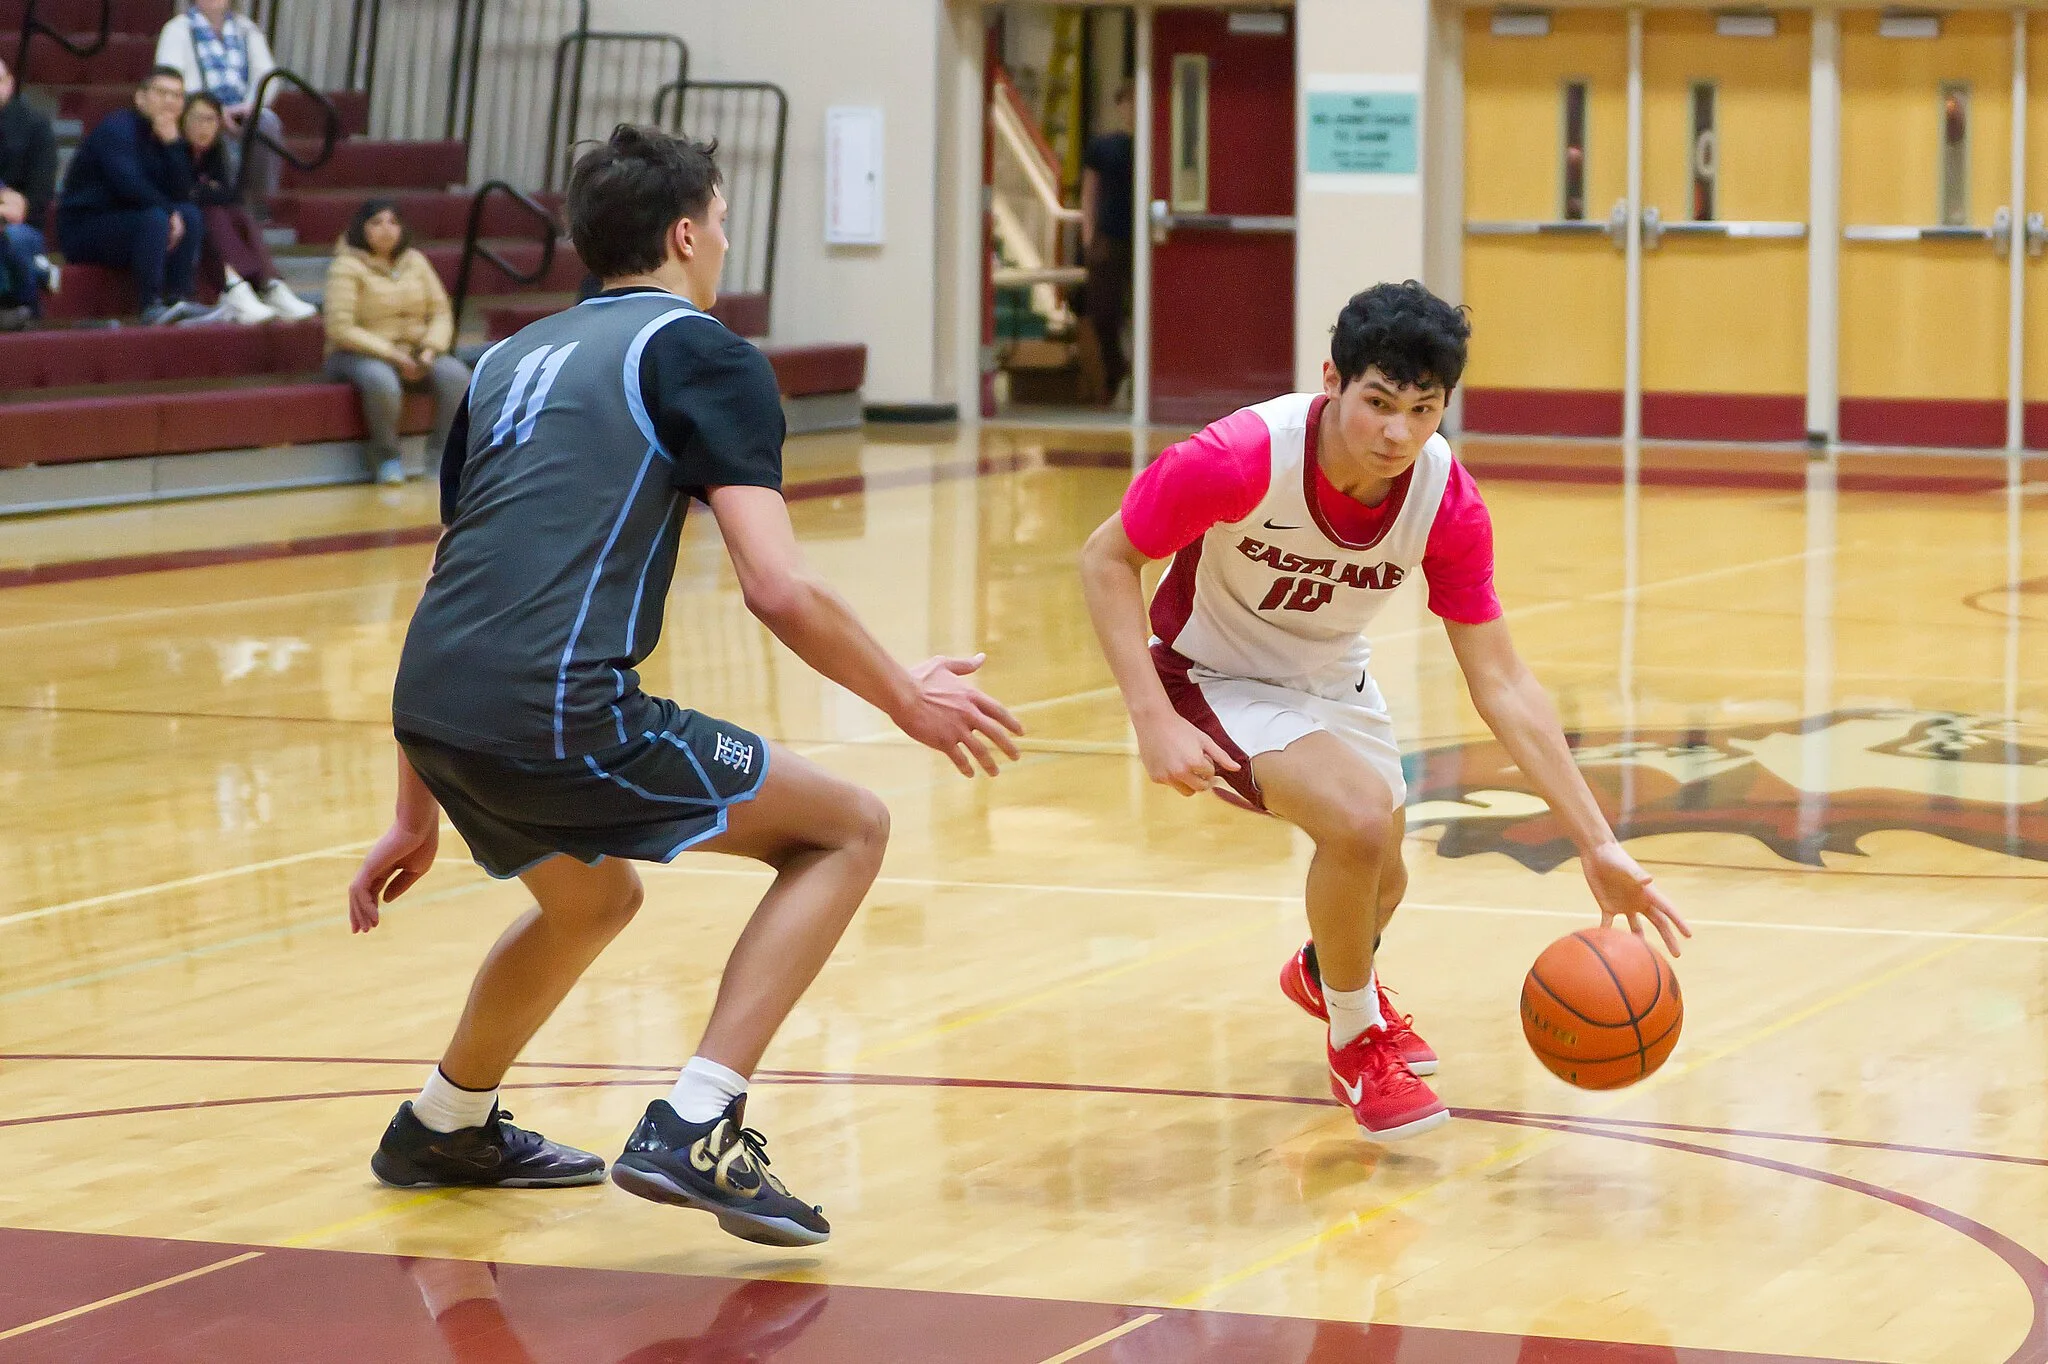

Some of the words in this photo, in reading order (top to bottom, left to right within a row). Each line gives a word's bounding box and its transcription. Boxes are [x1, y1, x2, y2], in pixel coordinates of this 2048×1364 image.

[490, 341, 580, 446] 11
[1236, 536, 1405, 590] EASTLAKE
[1258, 576, 1336, 612] 10
